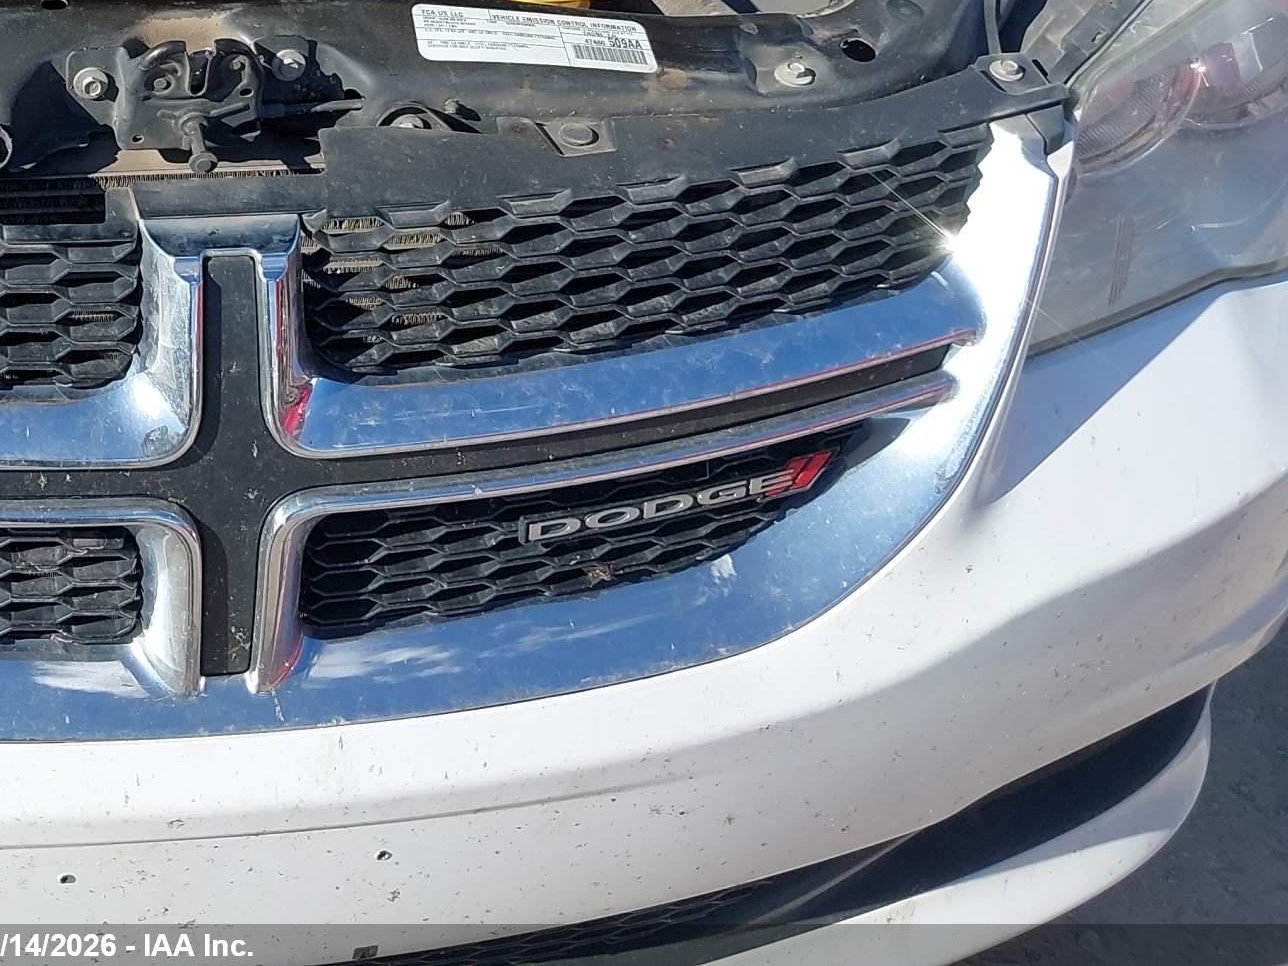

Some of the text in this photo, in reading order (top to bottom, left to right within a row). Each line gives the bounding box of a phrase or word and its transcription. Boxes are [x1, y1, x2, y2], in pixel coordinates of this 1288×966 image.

[492, 14, 520, 23] VEHICLE
[522, 16, 555, 26] EMISSION
[556, 19, 588, 28] CONTROL
[590, 22, 637, 32] INFORMATION
[528, 468, 795, 541] DODGE
